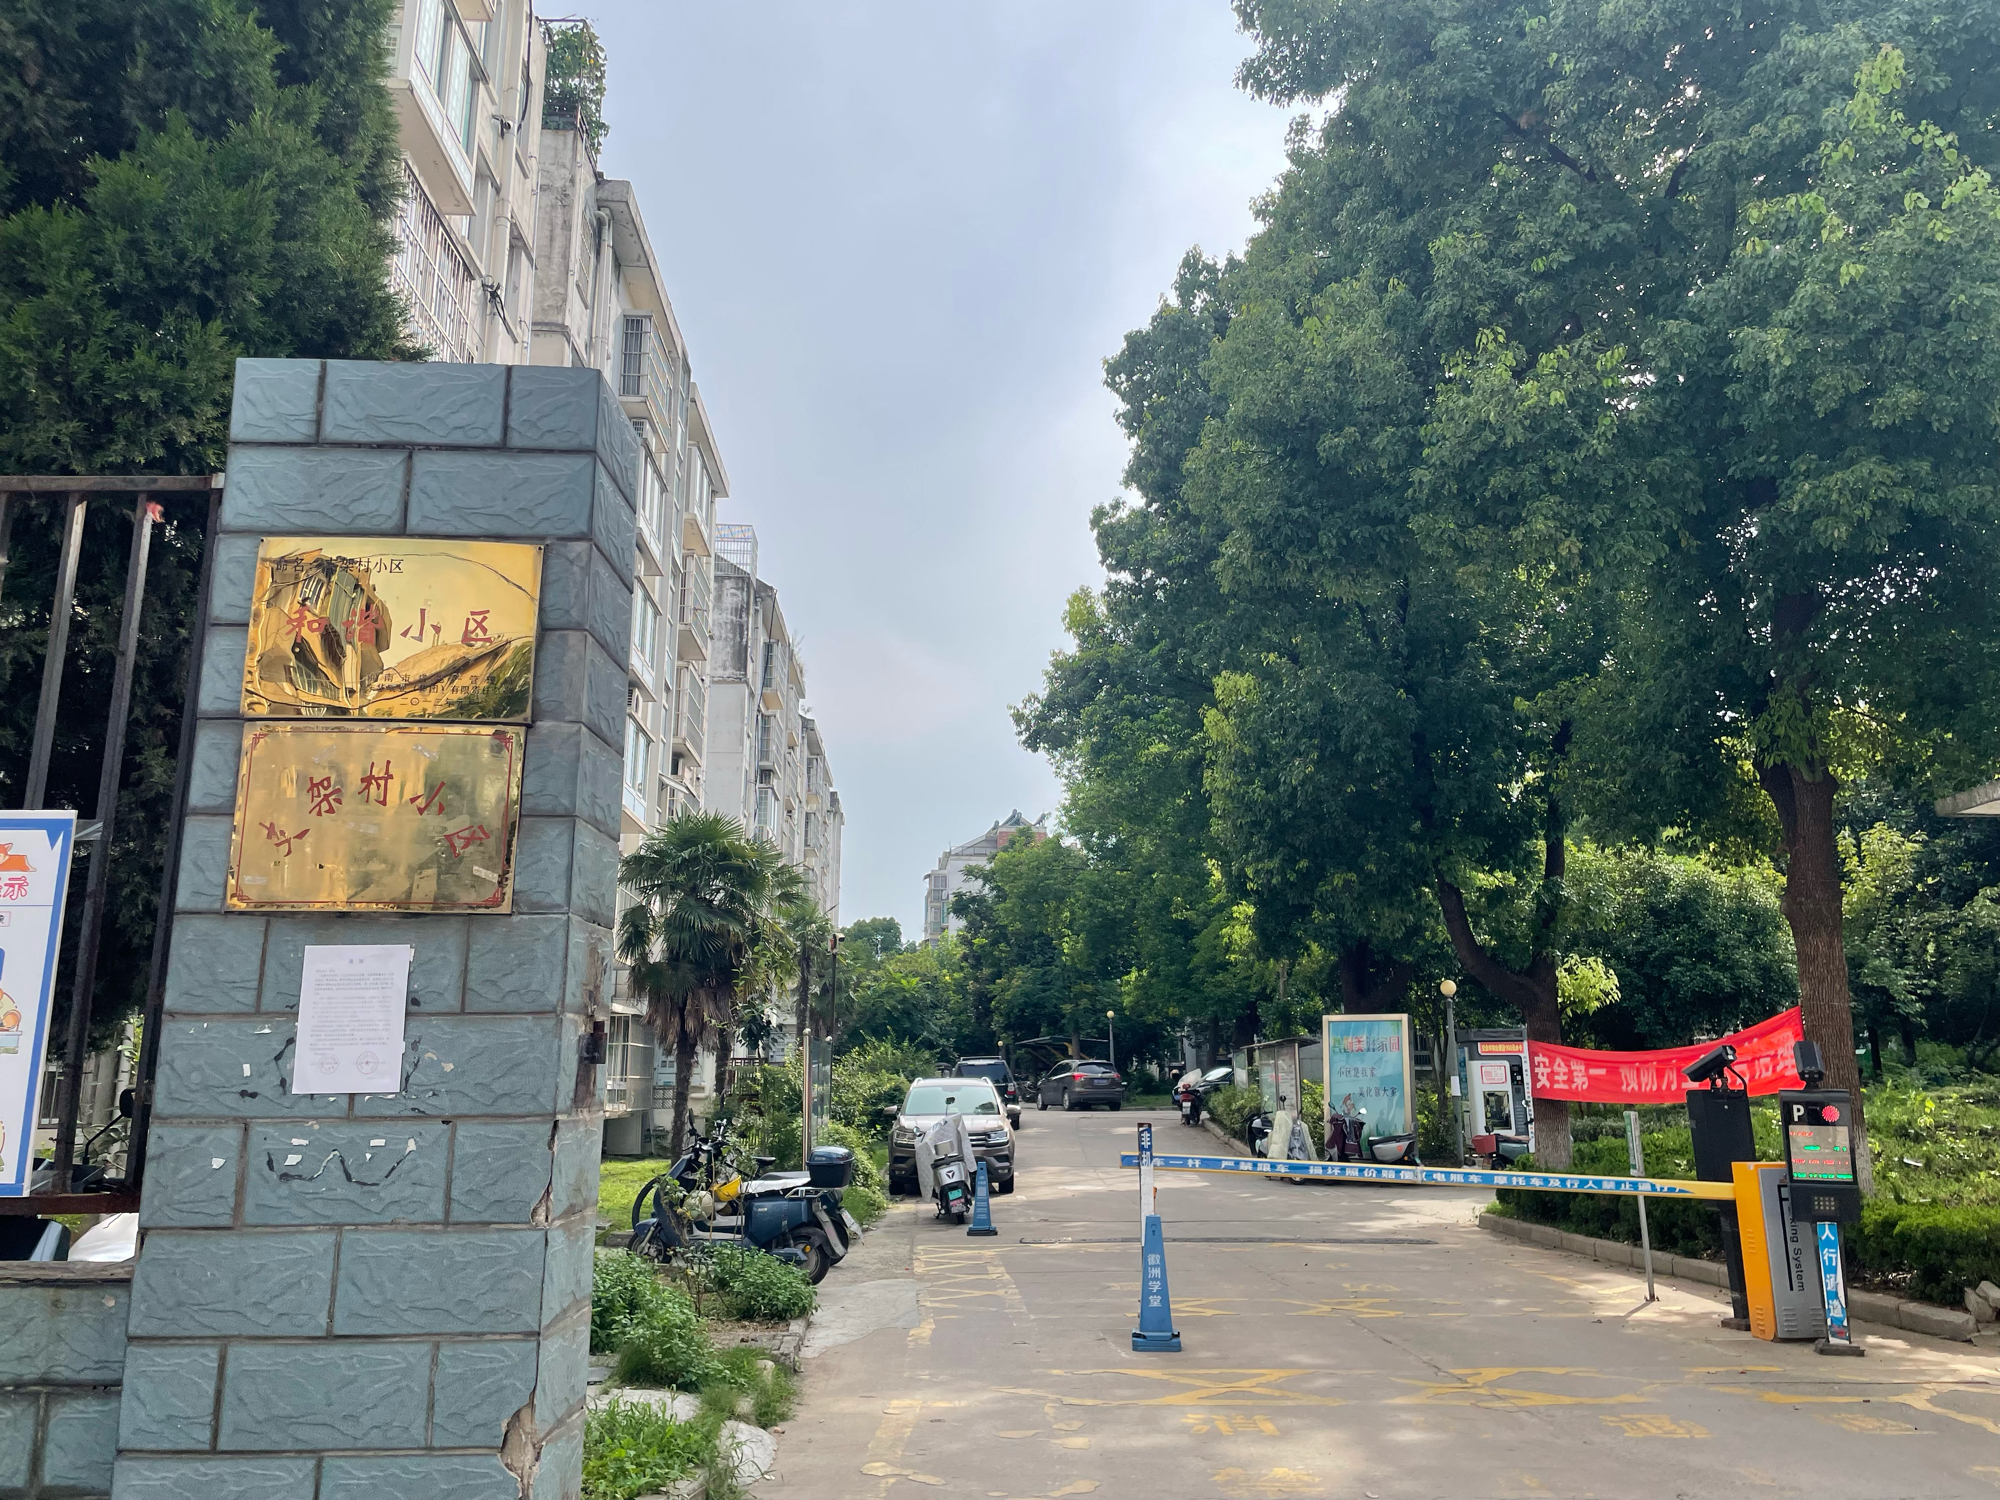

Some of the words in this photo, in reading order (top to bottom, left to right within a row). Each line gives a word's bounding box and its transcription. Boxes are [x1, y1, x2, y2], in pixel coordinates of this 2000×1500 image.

[286, 606, 493, 646] 和谐小区
[0, 875, 29, 901] 示
[1331, 1035, 1400, 1054] 共创美好家园
[1337, 1066, 1377, 1078] 小区是我家
[1534, 1053, 1607, 1091] 安全第一
[1792, 1104, 1805, 1122] P
[1220, 1160, 1290, 1174] 严禁跟车
[1147, 1253, 1163, 1308] 徽洲学堂
[1791, 1247, 1806, 1293] System
[1821, 1223, 1844, 1318] 人行通道
